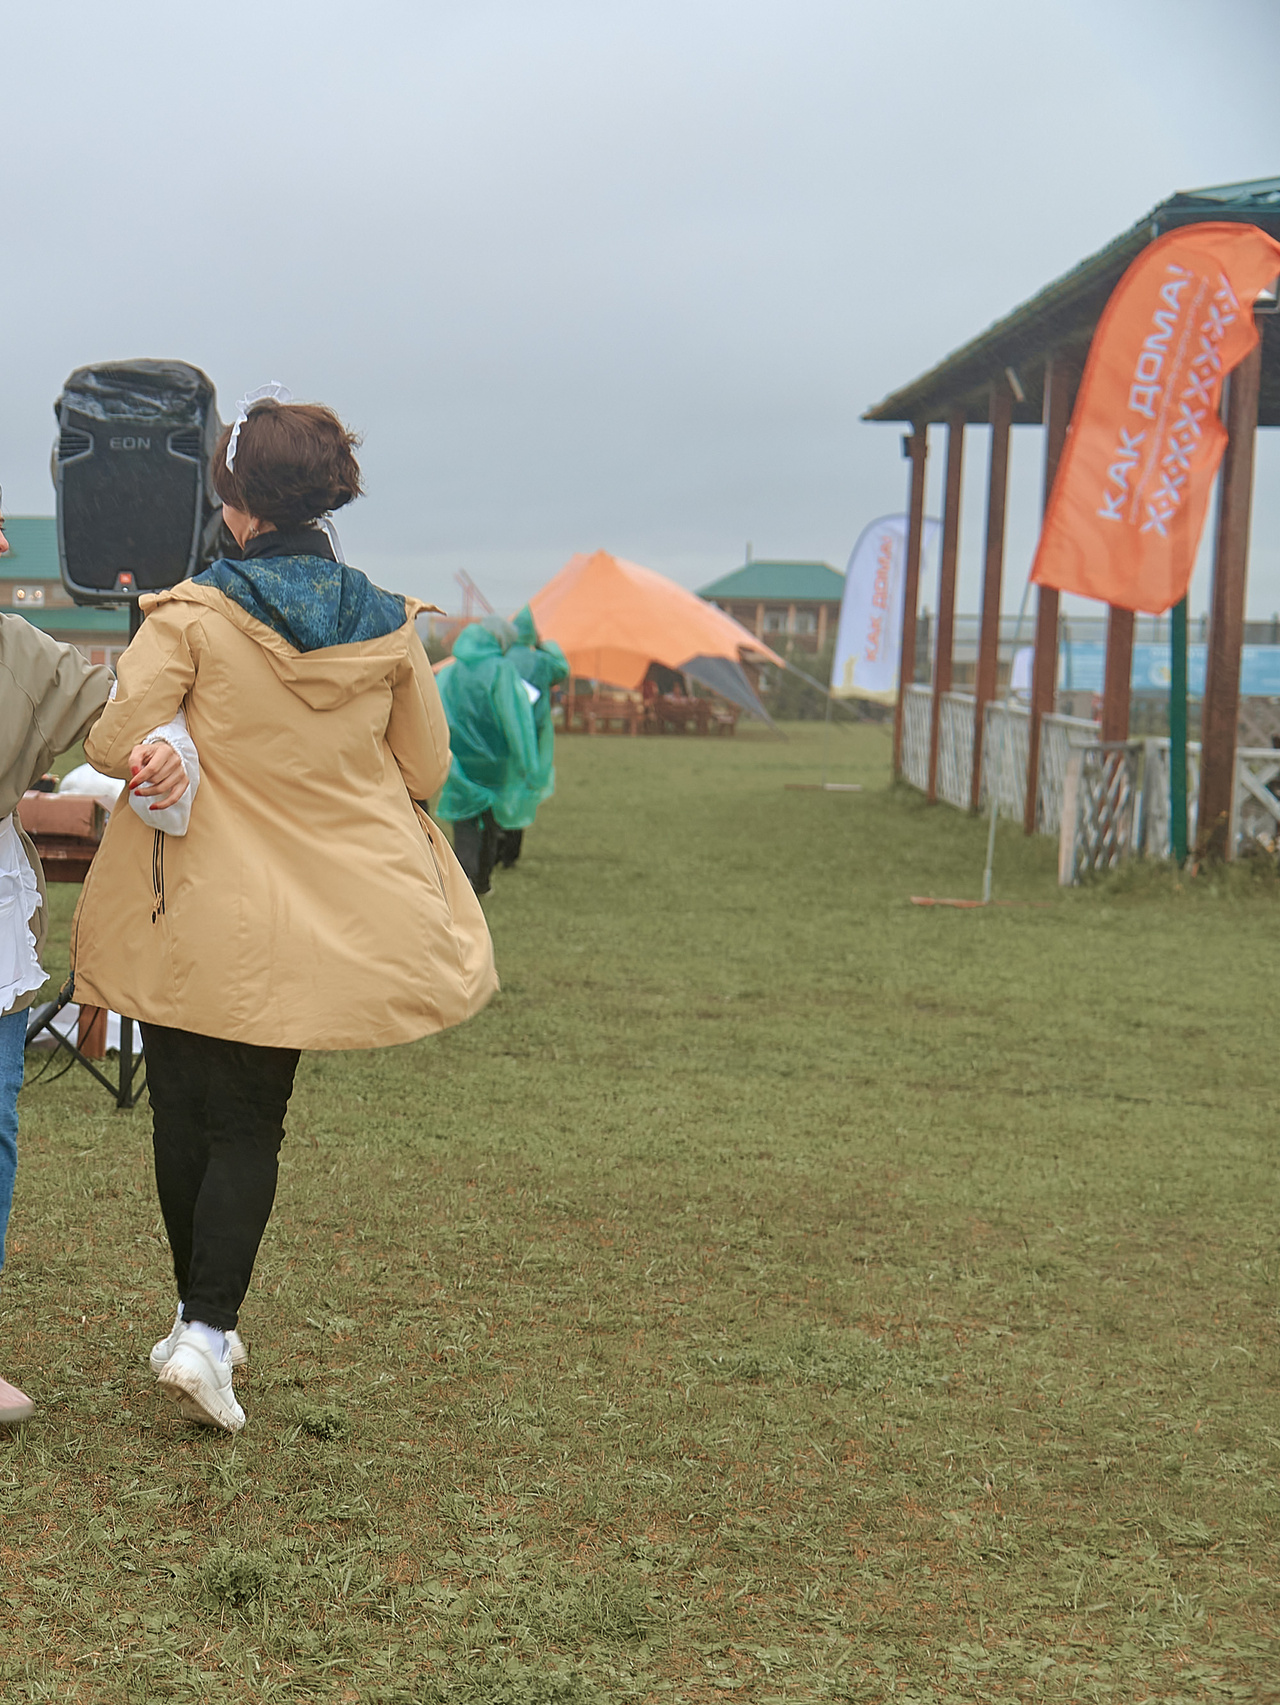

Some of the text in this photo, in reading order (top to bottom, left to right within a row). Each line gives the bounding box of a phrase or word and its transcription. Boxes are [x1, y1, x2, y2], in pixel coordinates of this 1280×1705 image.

[1096, 427, 1147, 521] КАК
[1129, 263, 1194, 419] ДОМА!
[109, 435, 152, 450] EON
[865, 615, 883, 662] КАК
